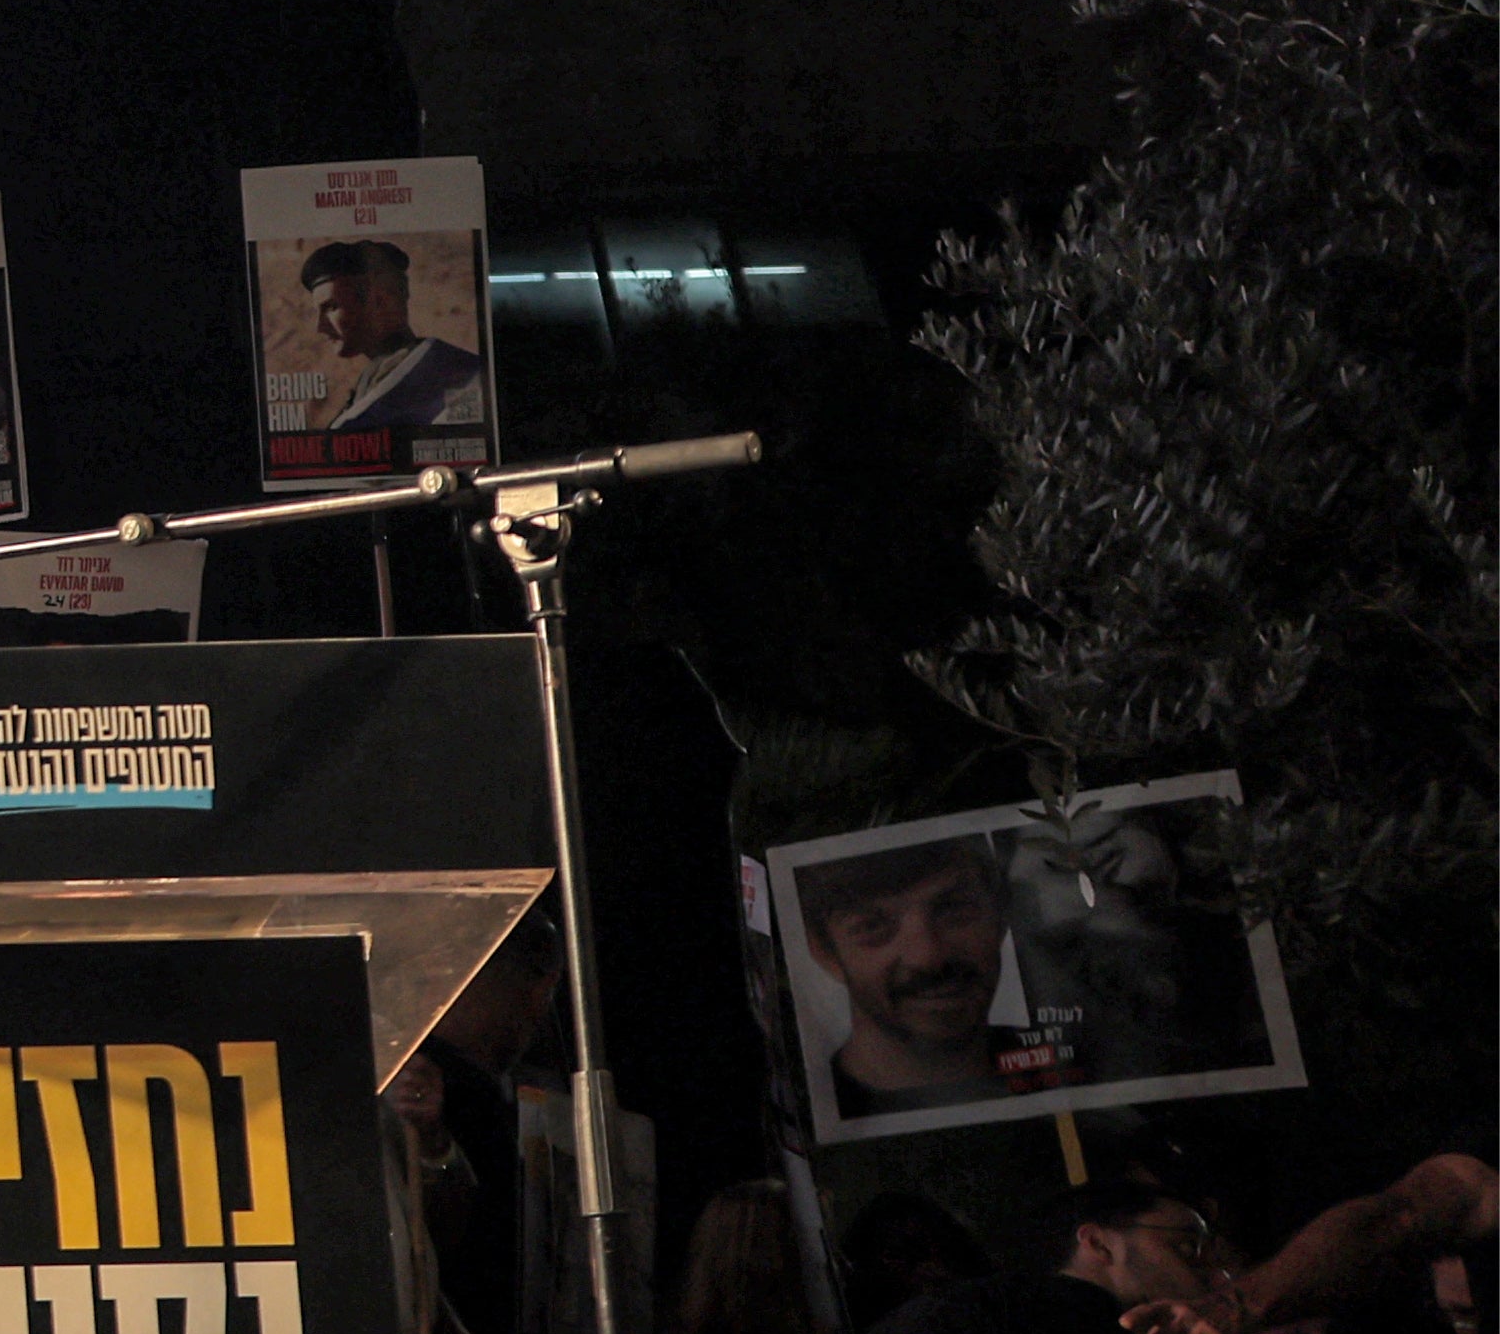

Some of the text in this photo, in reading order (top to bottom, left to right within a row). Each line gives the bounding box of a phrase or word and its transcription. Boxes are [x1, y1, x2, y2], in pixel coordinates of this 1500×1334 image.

[315, 186, 413, 210] MATAN ANGREST
[39, 572, 124, 594] EVYATAR DAVID
[32, 705, 152, 744] המשפחות
[156, 703, 212, 742] מטה
[86, 744, 216, 794] החטופים
